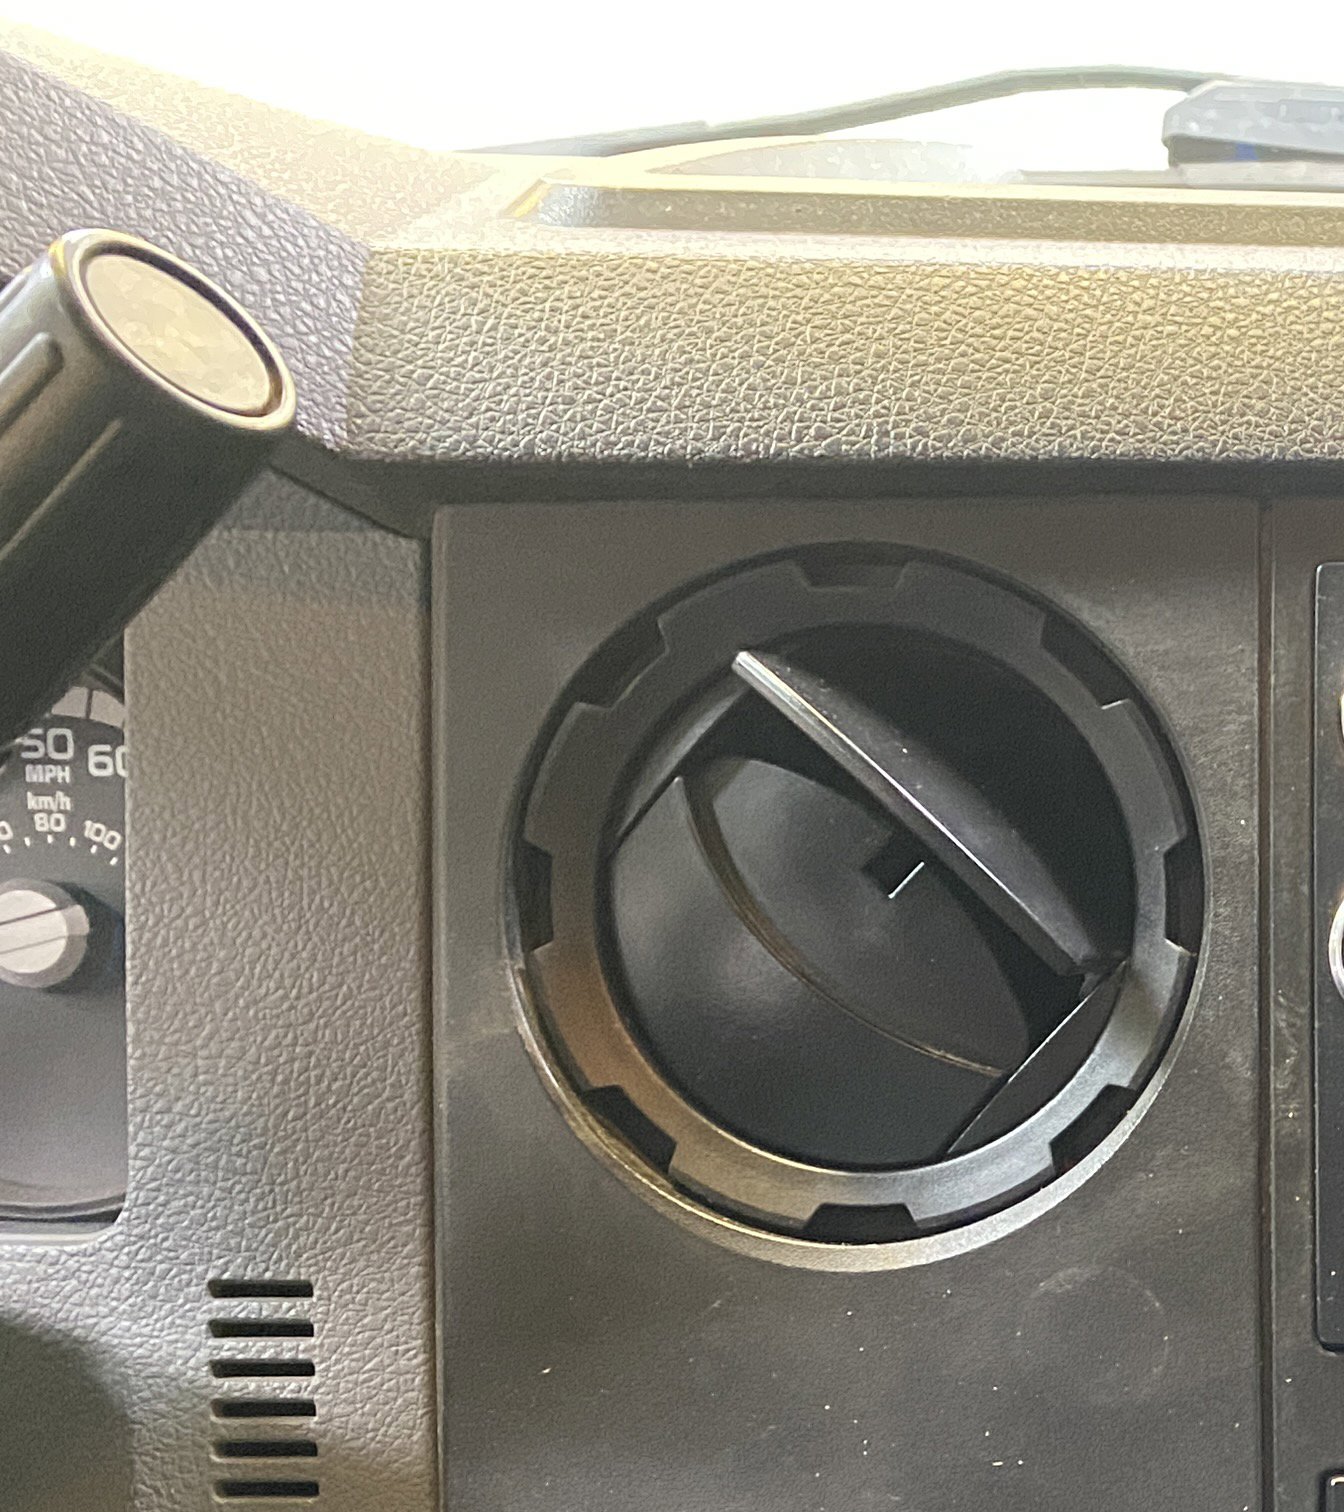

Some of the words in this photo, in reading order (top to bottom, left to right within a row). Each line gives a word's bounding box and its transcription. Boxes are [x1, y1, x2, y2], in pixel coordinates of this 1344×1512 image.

[20, 727, 75, 760] 50
[25, 763, 71, 784] MPH
[26, 790, 72, 811] km/h
[0, 820, 13, 841] 0
[34, 812, 66, 832] 80
[83, 820, 122, 850] 100
